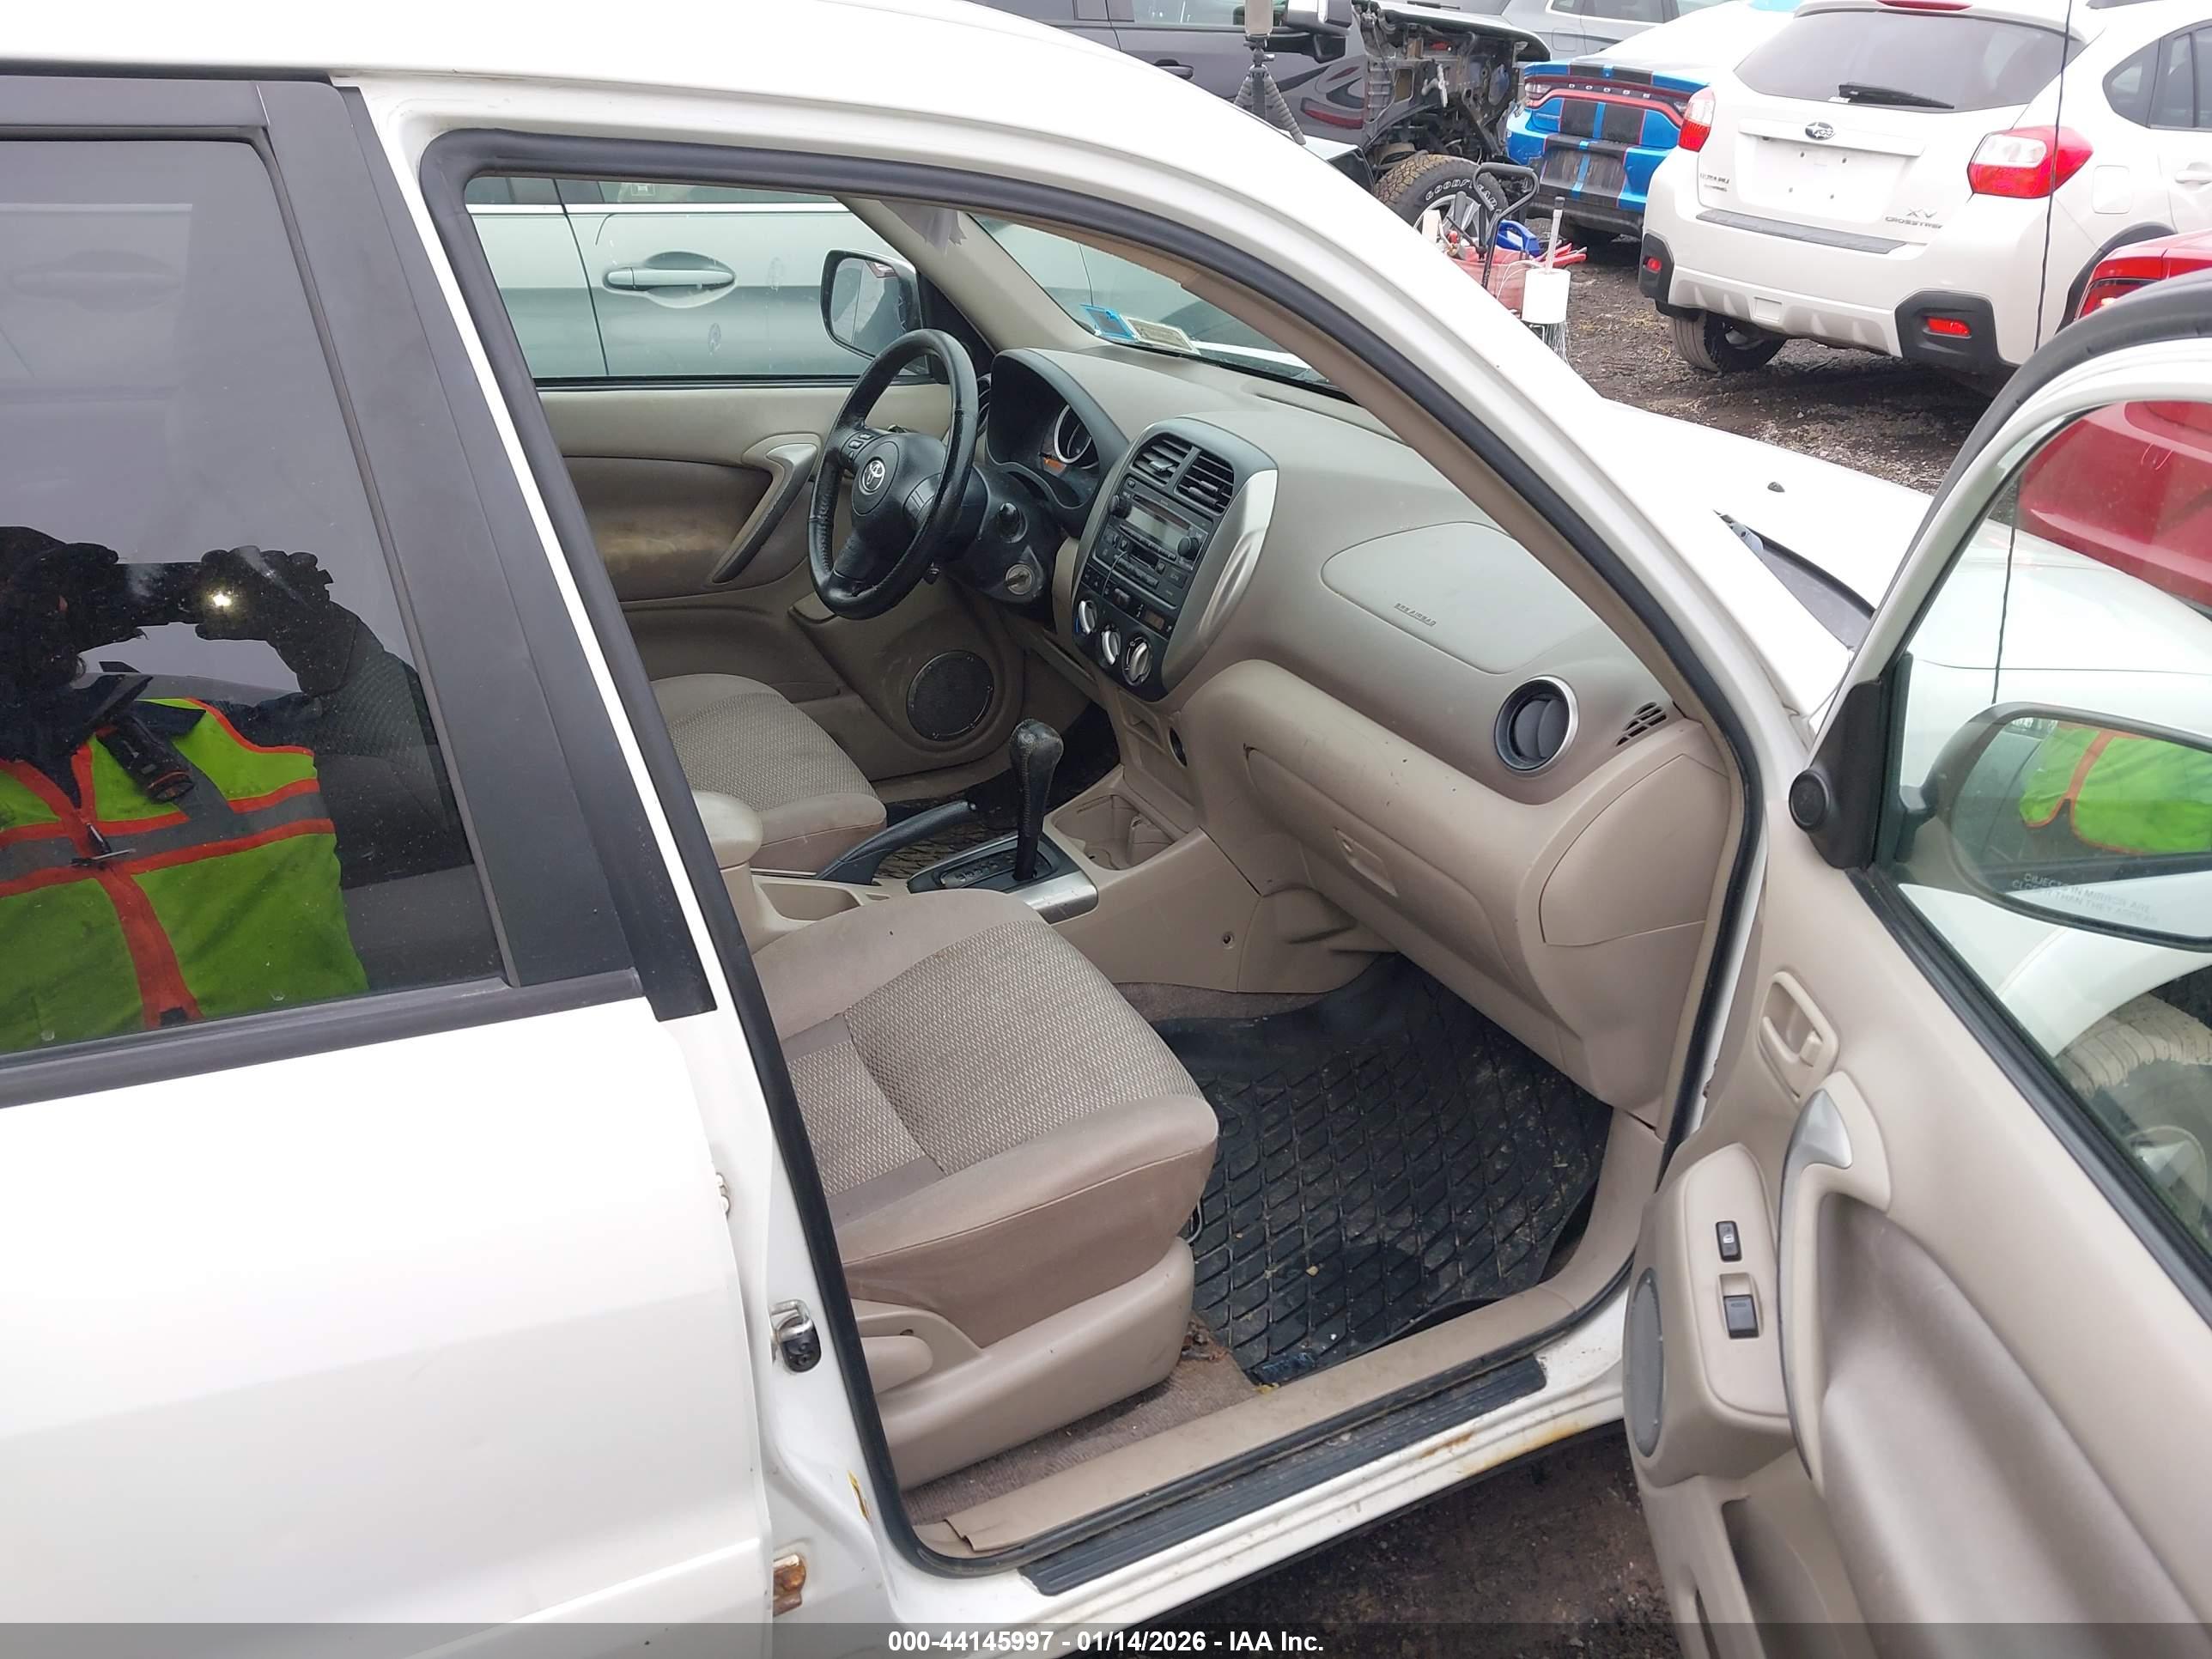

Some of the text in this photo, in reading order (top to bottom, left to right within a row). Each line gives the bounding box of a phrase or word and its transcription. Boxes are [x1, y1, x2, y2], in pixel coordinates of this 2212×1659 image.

[1568, 83, 1651, 99] DODGE
[1425, 179, 1498, 207] GOODEAR
[1906, 208, 1938, 219] XV
[1408, 609, 1437, 627] AIRBAG
[2012, 879, 2053, 898] CLOR
